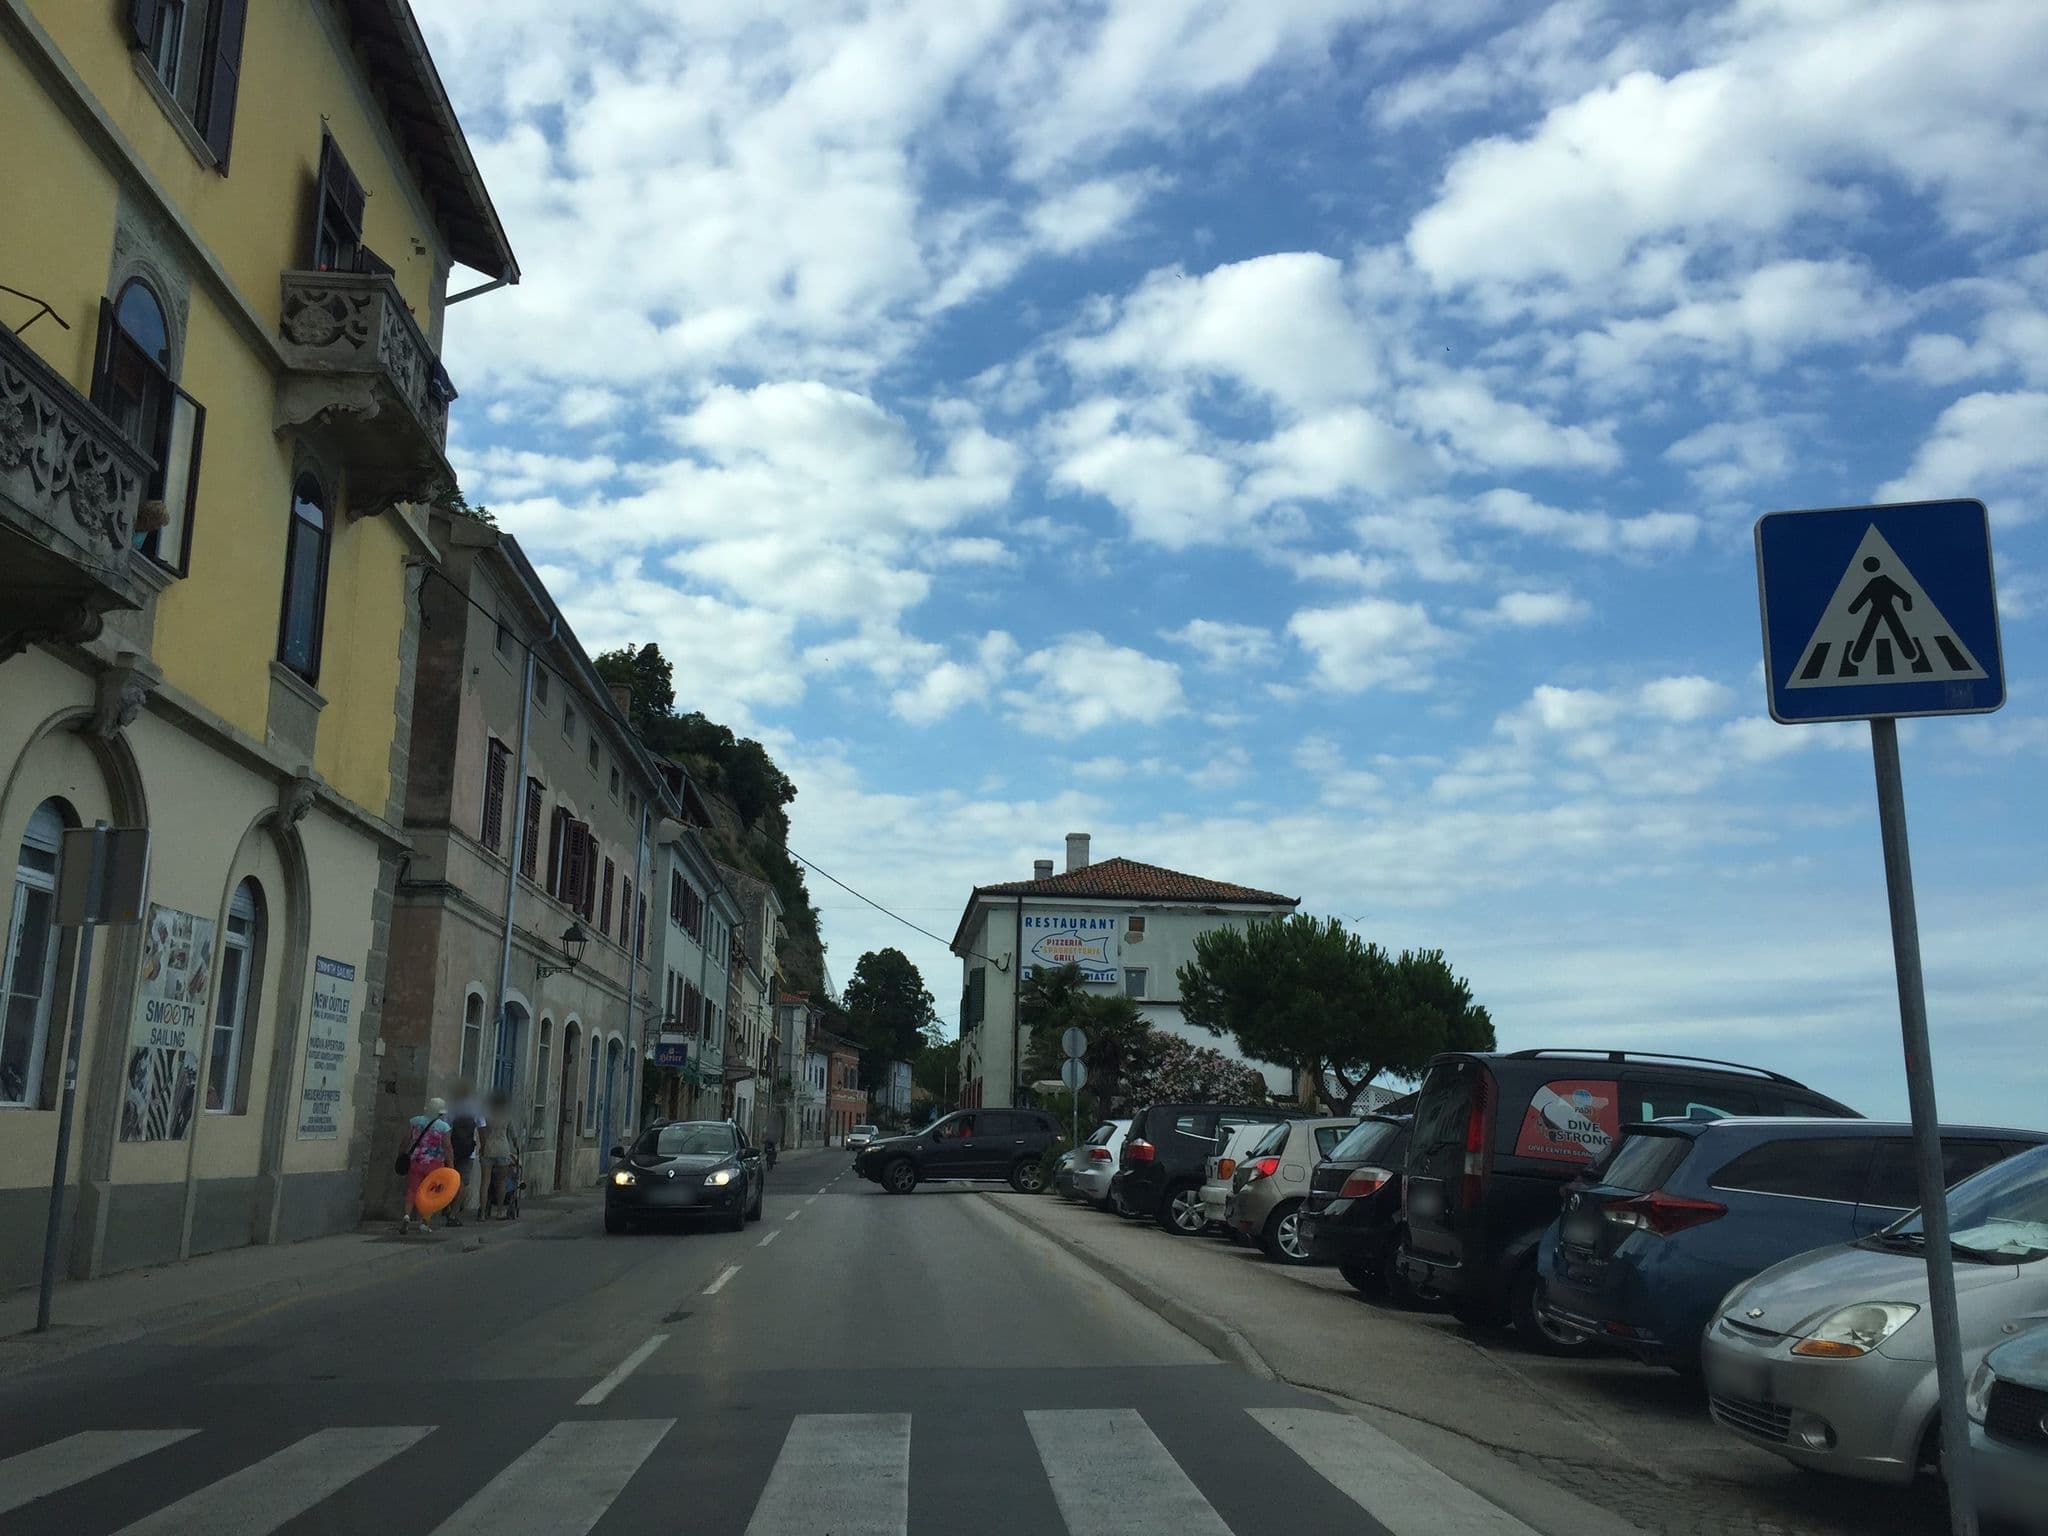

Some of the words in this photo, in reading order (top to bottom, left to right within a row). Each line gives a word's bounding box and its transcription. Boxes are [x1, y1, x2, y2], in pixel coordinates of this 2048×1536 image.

[1025, 917, 1115, 930] RESTAURANT
[1046, 938, 1083, 947] PIZZERIA
[1053, 954, 1076, 962] GRILL
[314, 992, 328, 1009] NEW
[329, 996, 350, 1014] OUTLET
[146, 999, 195, 1026] SMOOTH
[150, 1028, 185, 1048] SAILING
[1574, 1106, 1592, 1115] PADI
[1568, 1120, 1600, 1133] DIVE
[1556, 1130, 1612, 1146] STRONG
[1528, 1144, 1544, 1152] DIVE
[1545, 1147, 1572, 1155] CENTER
